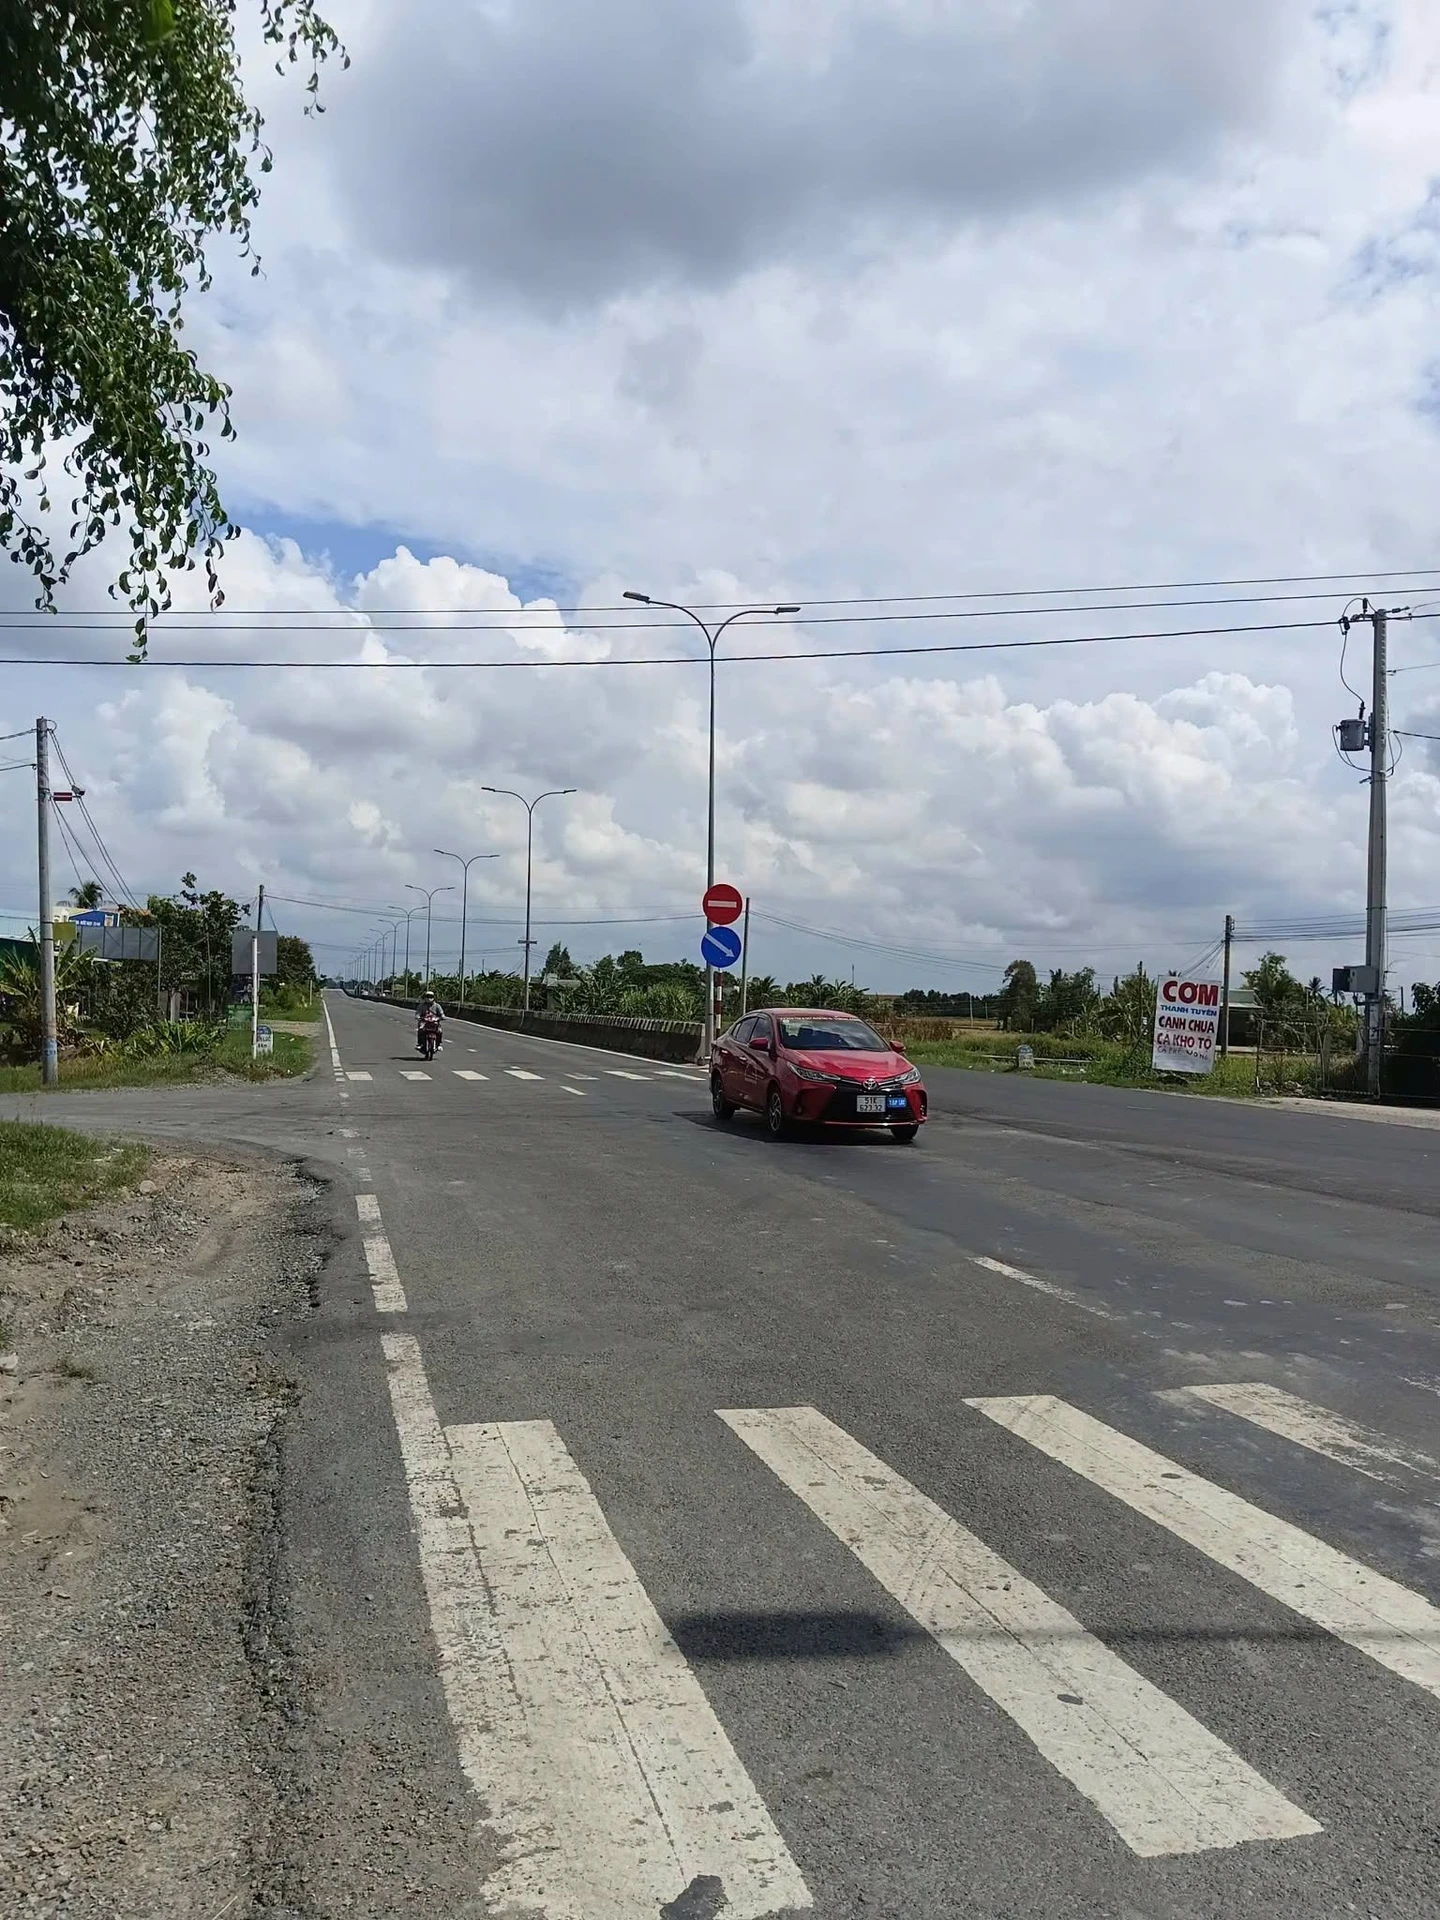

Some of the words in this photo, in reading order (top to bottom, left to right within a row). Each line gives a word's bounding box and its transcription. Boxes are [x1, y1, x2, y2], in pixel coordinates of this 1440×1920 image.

[1163, 980, 1219, 1006] CƠM
[1160, 1005, 1189, 1015] THANH
[1158, 1016, 1186, 1031] CANH
[1188, 1019, 1215, 1034] CHUA
[1173, 1034, 1195, 1049] KHO
